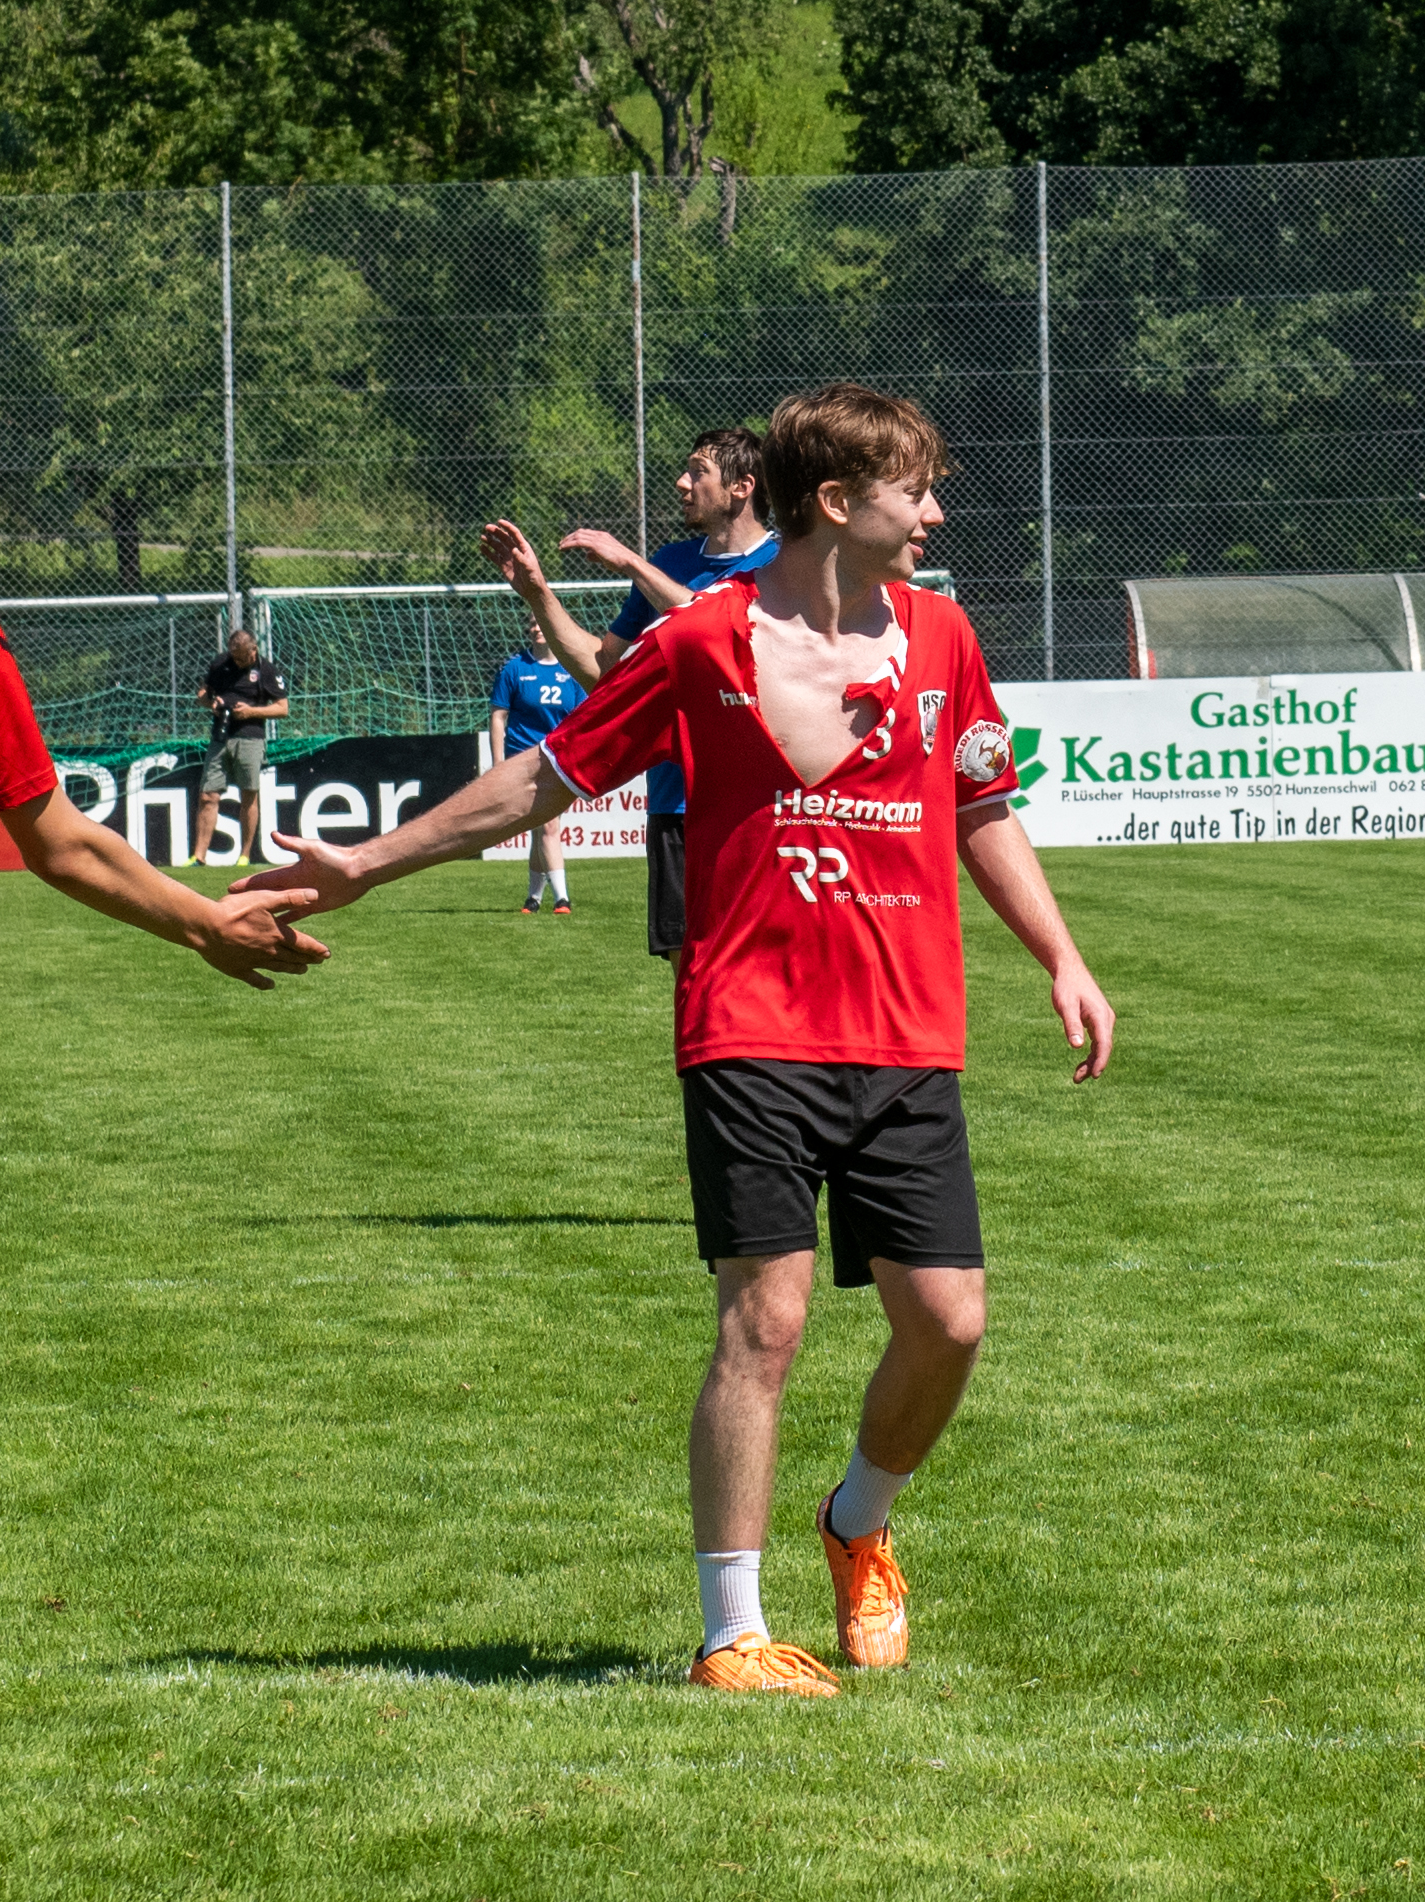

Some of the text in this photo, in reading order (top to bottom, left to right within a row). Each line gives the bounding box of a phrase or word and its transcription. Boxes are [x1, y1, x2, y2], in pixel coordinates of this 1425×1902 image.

[539, 685, 563, 705] 22
[1190, 687, 1358, 728] Gasthof
[1060, 729, 1425, 783] Kastanienbau
[774, 788, 923, 823] Heizmann
[1061, 790, 1070, 802] P.
[1074, 788, 1123, 802] Lüscher
[1132, 787, 1222, 802] Hauptstrasse
[1225, 786, 1239, 798] 19
[1247, 784, 1283, 797] 5502
[1285, 780, 1377, 795] Hunzenschwil
[1388, 780, 1416, 792] 062
[590, 831, 614, 846] zu
[1230, 808, 1266, 842] Tip
[1276, 810, 1296, 837] in
[1305, 807, 1341, 836] der
[776, 846, 849, 903] RP
[834, 891, 852, 903] RP
